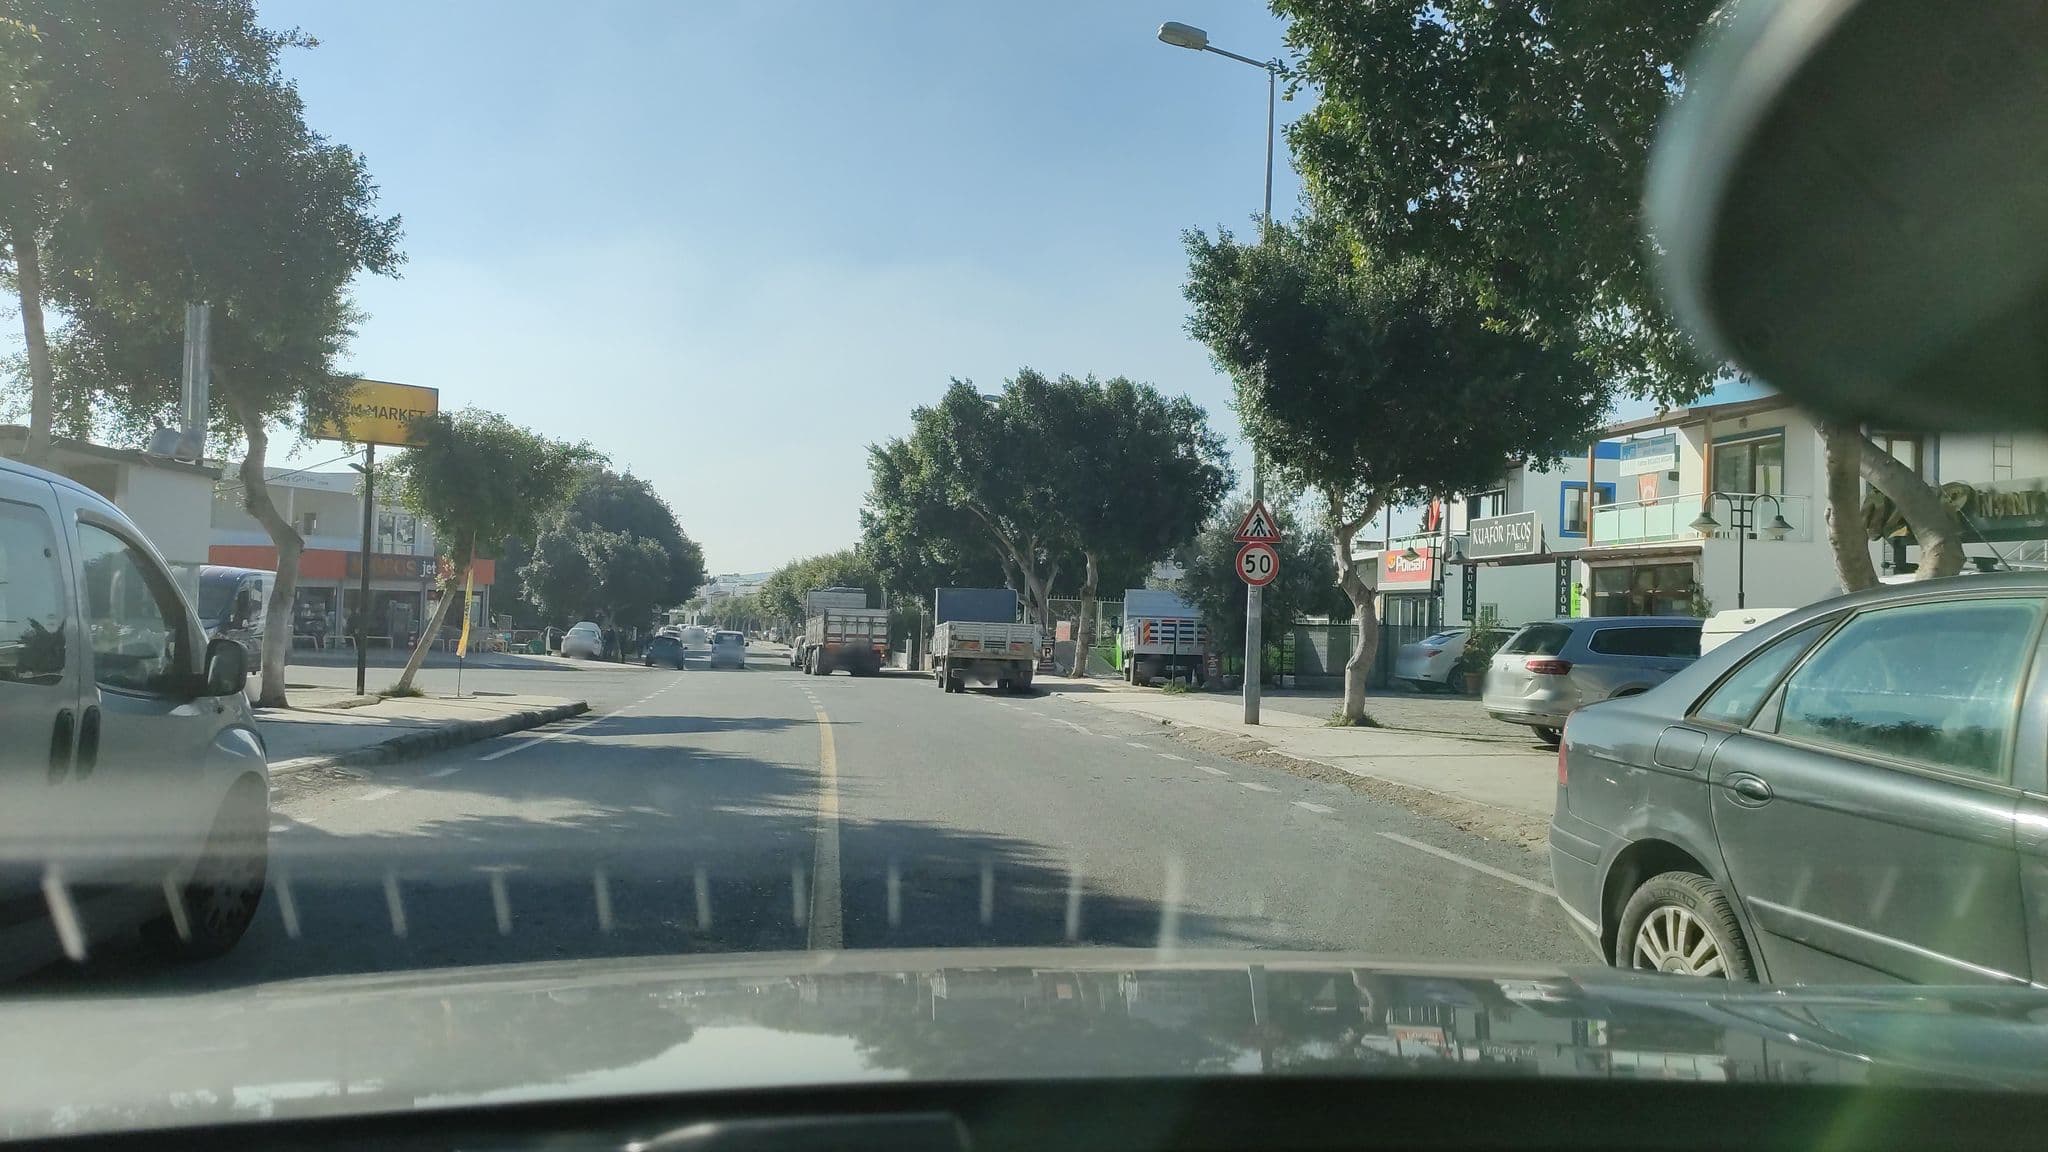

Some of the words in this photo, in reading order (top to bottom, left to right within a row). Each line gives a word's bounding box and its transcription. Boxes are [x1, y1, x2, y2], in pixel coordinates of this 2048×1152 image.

[367, 403, 427, 422] MARKET
[1472, 520, 1504, 546] KUAFÖR
[420, 560, 437, 578] jet
[1245, 554, 1271, 574] 50
[1560, 560, 1568, 613] KUAFÖR
